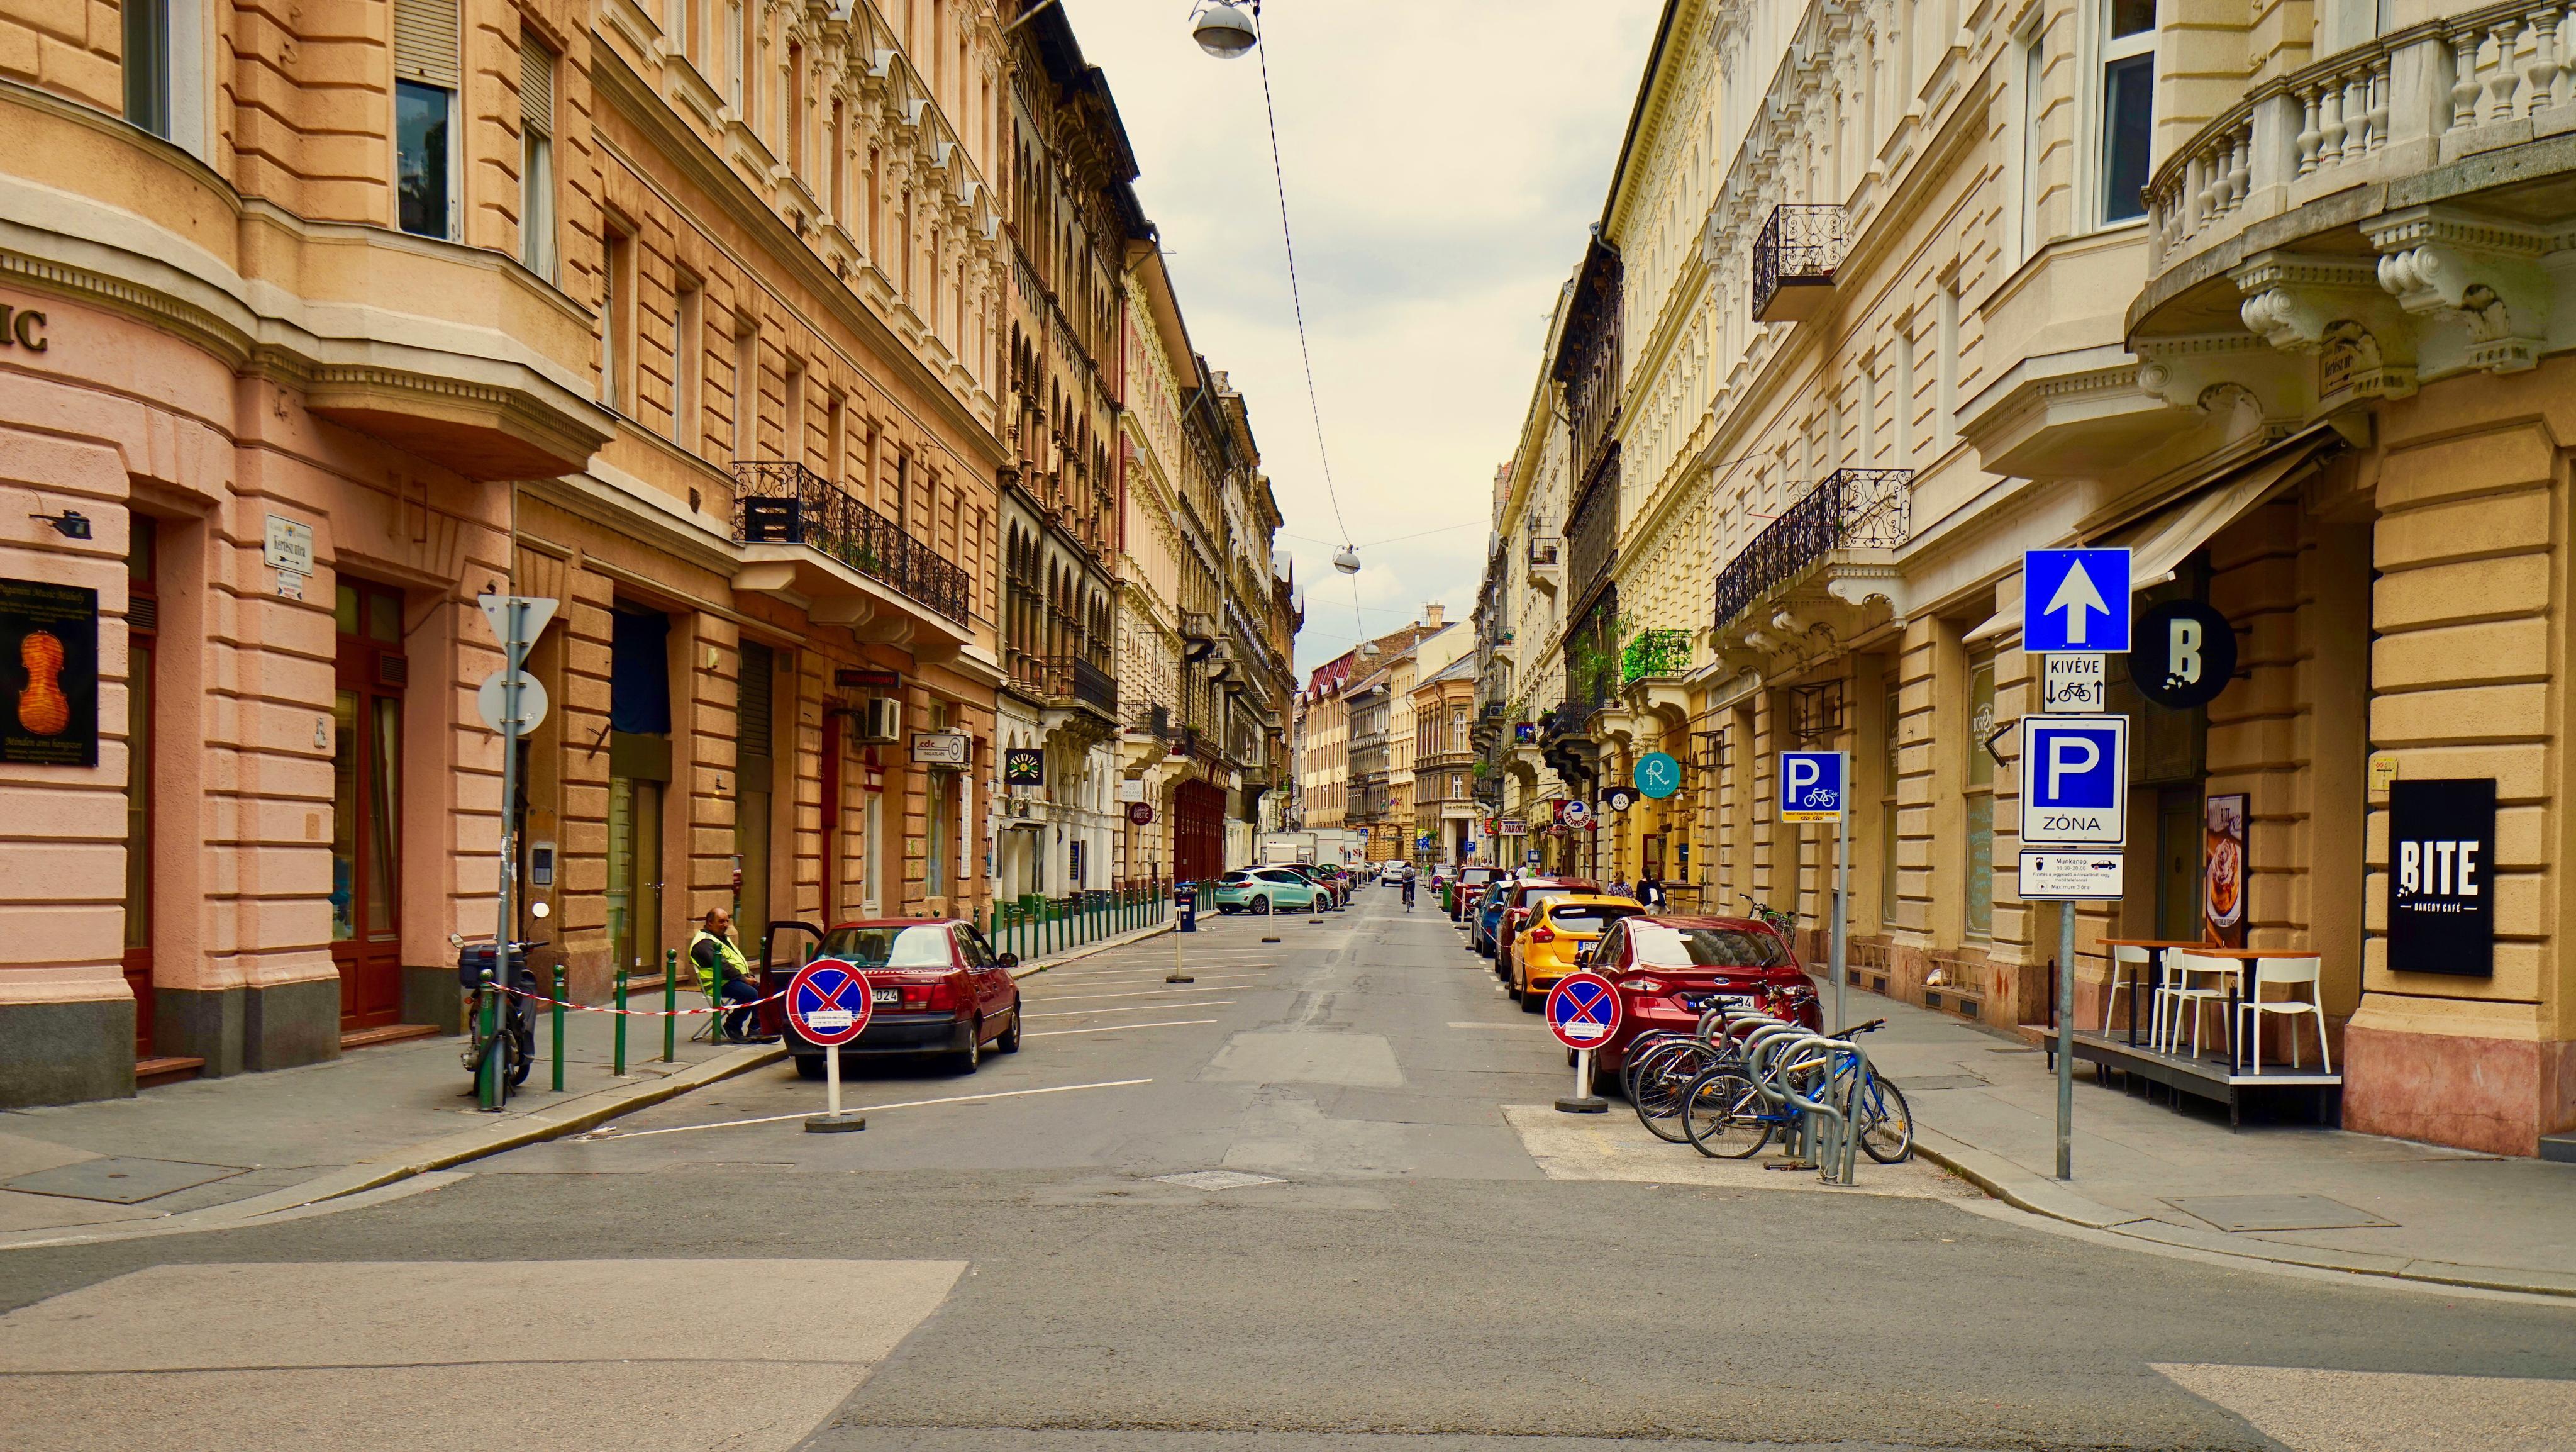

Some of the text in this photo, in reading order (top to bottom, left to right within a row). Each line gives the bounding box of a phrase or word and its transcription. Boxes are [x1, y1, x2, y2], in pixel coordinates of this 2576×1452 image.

[274, 535, 294, 554] Kertész
[294, 544, 306, 557] utca
[2169, 618, 2201, 684] B
[2051, 657, 2099, 673] KIVÉVE
[1646, 759, 1670, 786] R
[2048, 737, 2100, 800] P
[1789, 758, 1820, 803] P
[1504, 822, 1526, 833] PARÓKA
[1565, 812, 1590, 826] MOTOROSBOLT
[2043, 814, 2101, 831] ZÓNA
[2400, 840, 2479, 895] BITE
[2414, 902, 2460, 913] BAKERY CAFÉ
